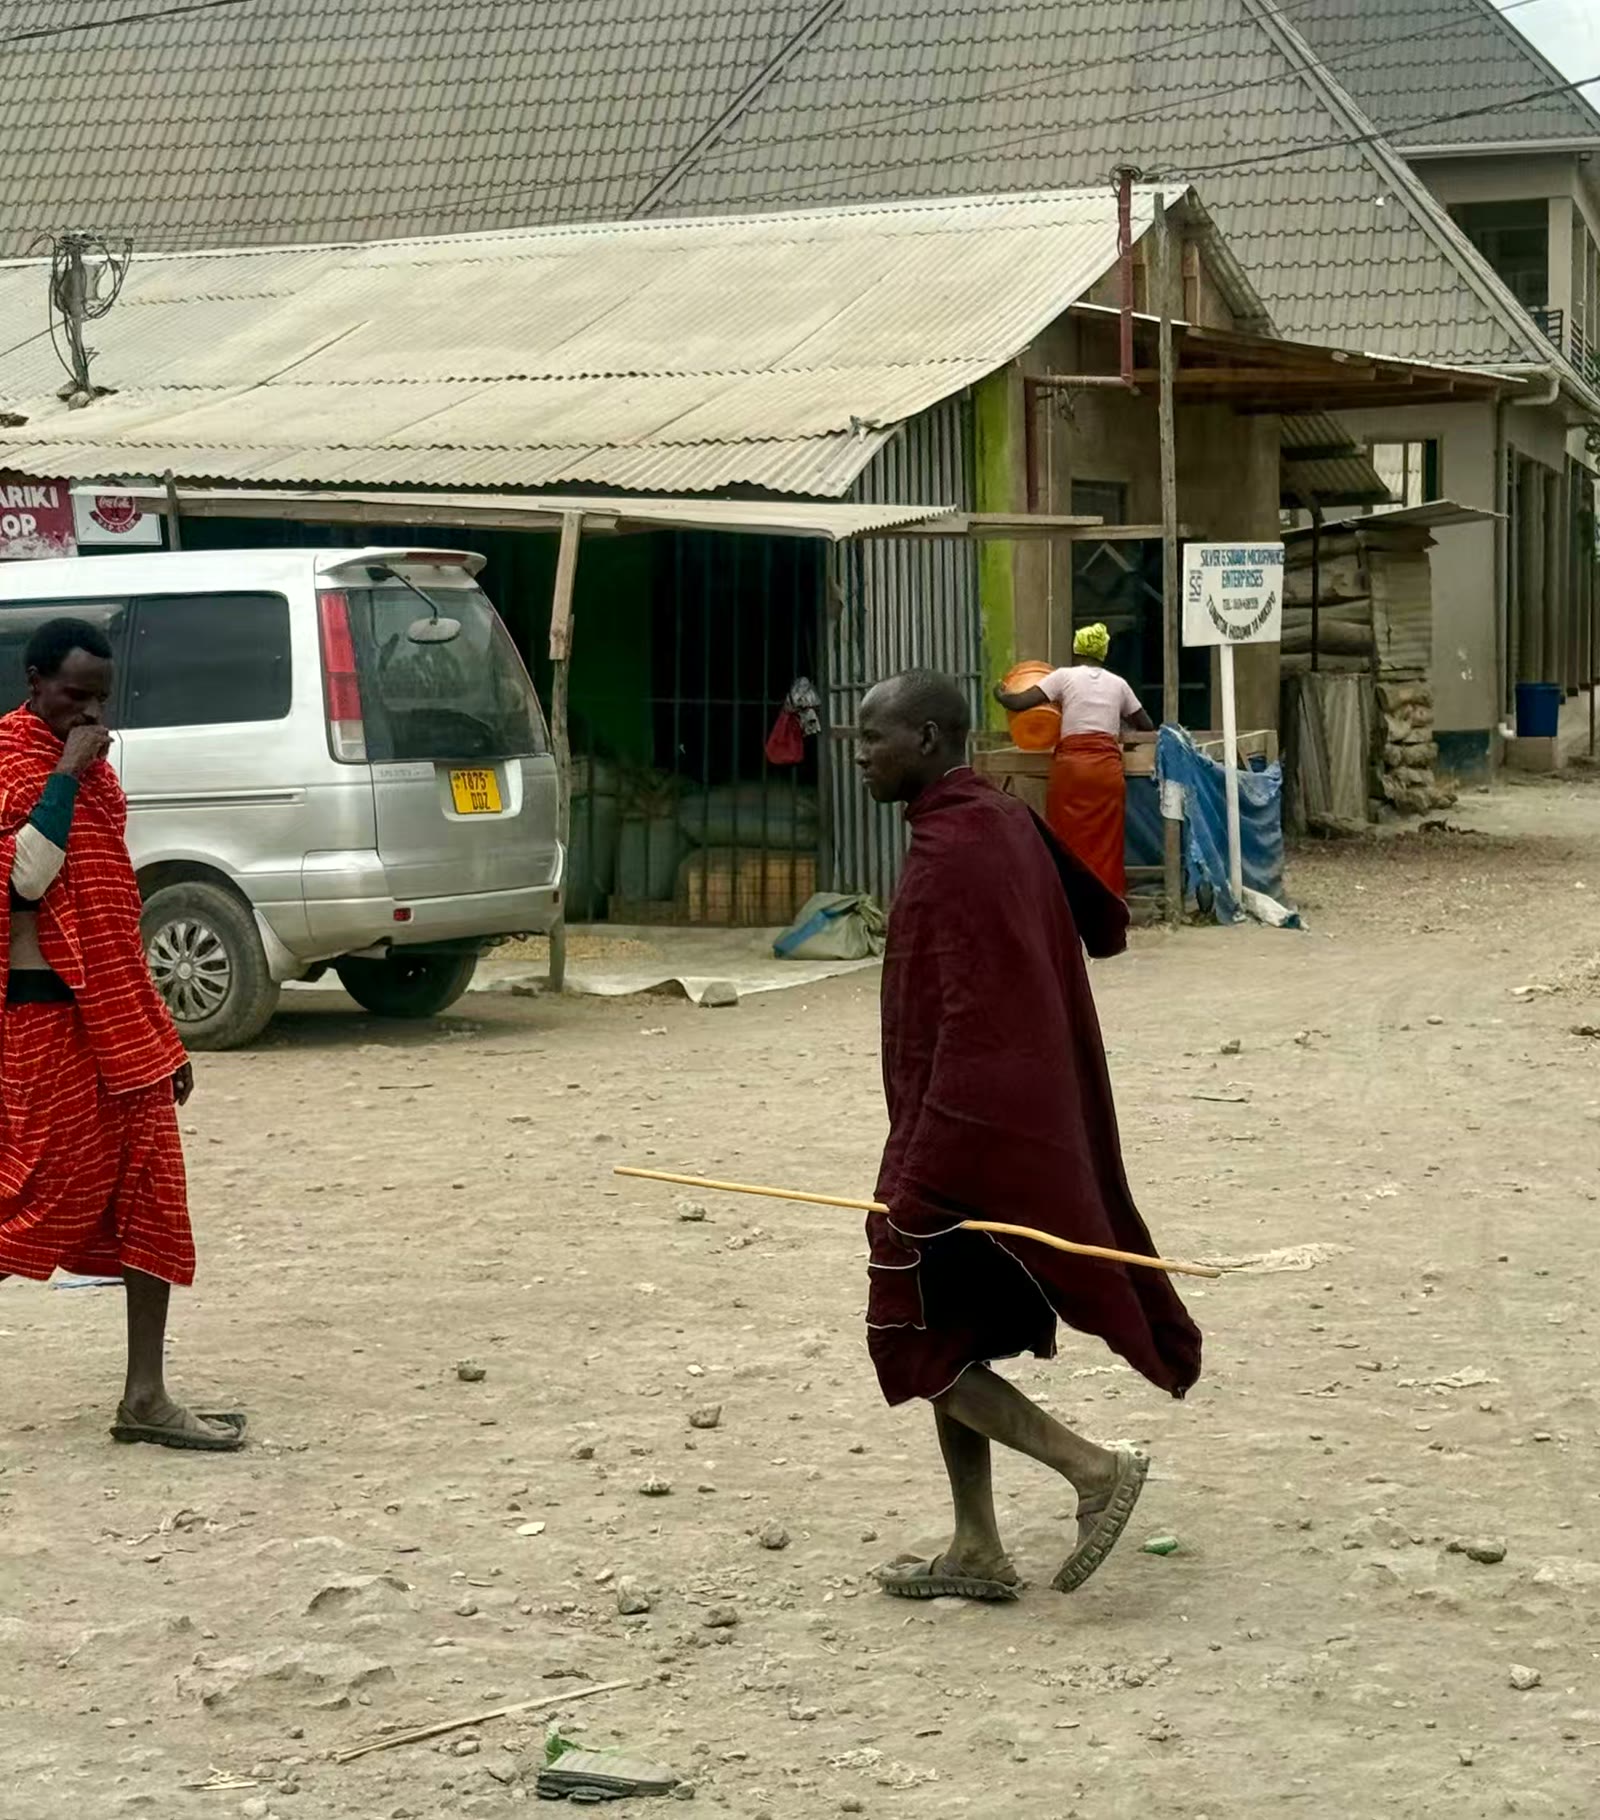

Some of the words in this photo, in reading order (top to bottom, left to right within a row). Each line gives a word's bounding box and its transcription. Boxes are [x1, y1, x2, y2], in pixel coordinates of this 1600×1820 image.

[0, 513, 37, 537] OP
[1221, 569, 1264, 589] ENTERPRISES
[460, 772, 487, 790] T875
[470, 792, 491, 810] DDZ
